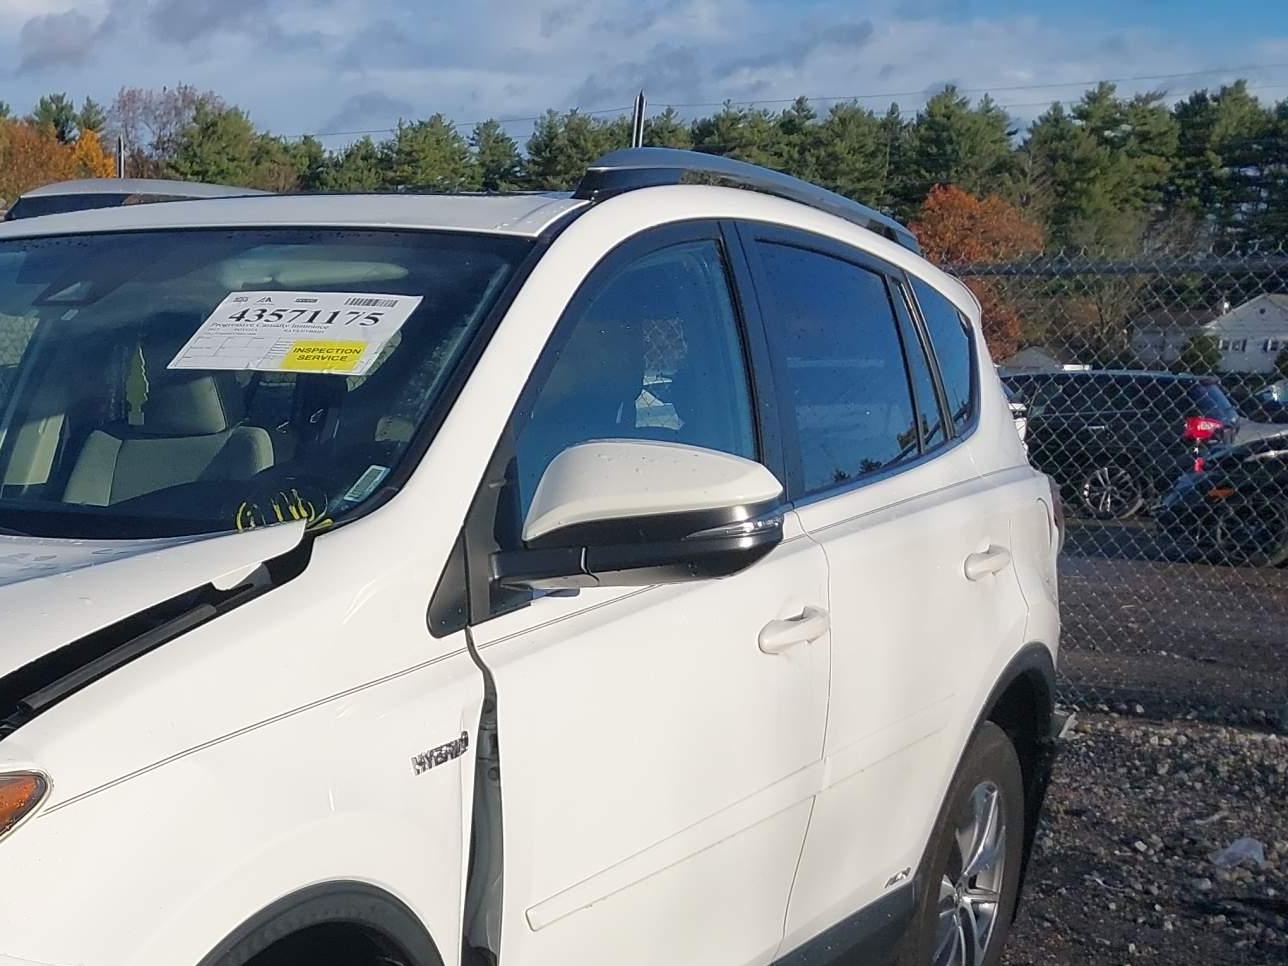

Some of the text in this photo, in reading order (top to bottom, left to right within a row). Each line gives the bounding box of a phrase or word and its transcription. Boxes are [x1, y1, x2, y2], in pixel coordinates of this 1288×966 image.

[228, 307, 384, 327] 43571175
[293, 346, 362, 355] INSPECTION
[296, 354, 349, 362] SERVICE
